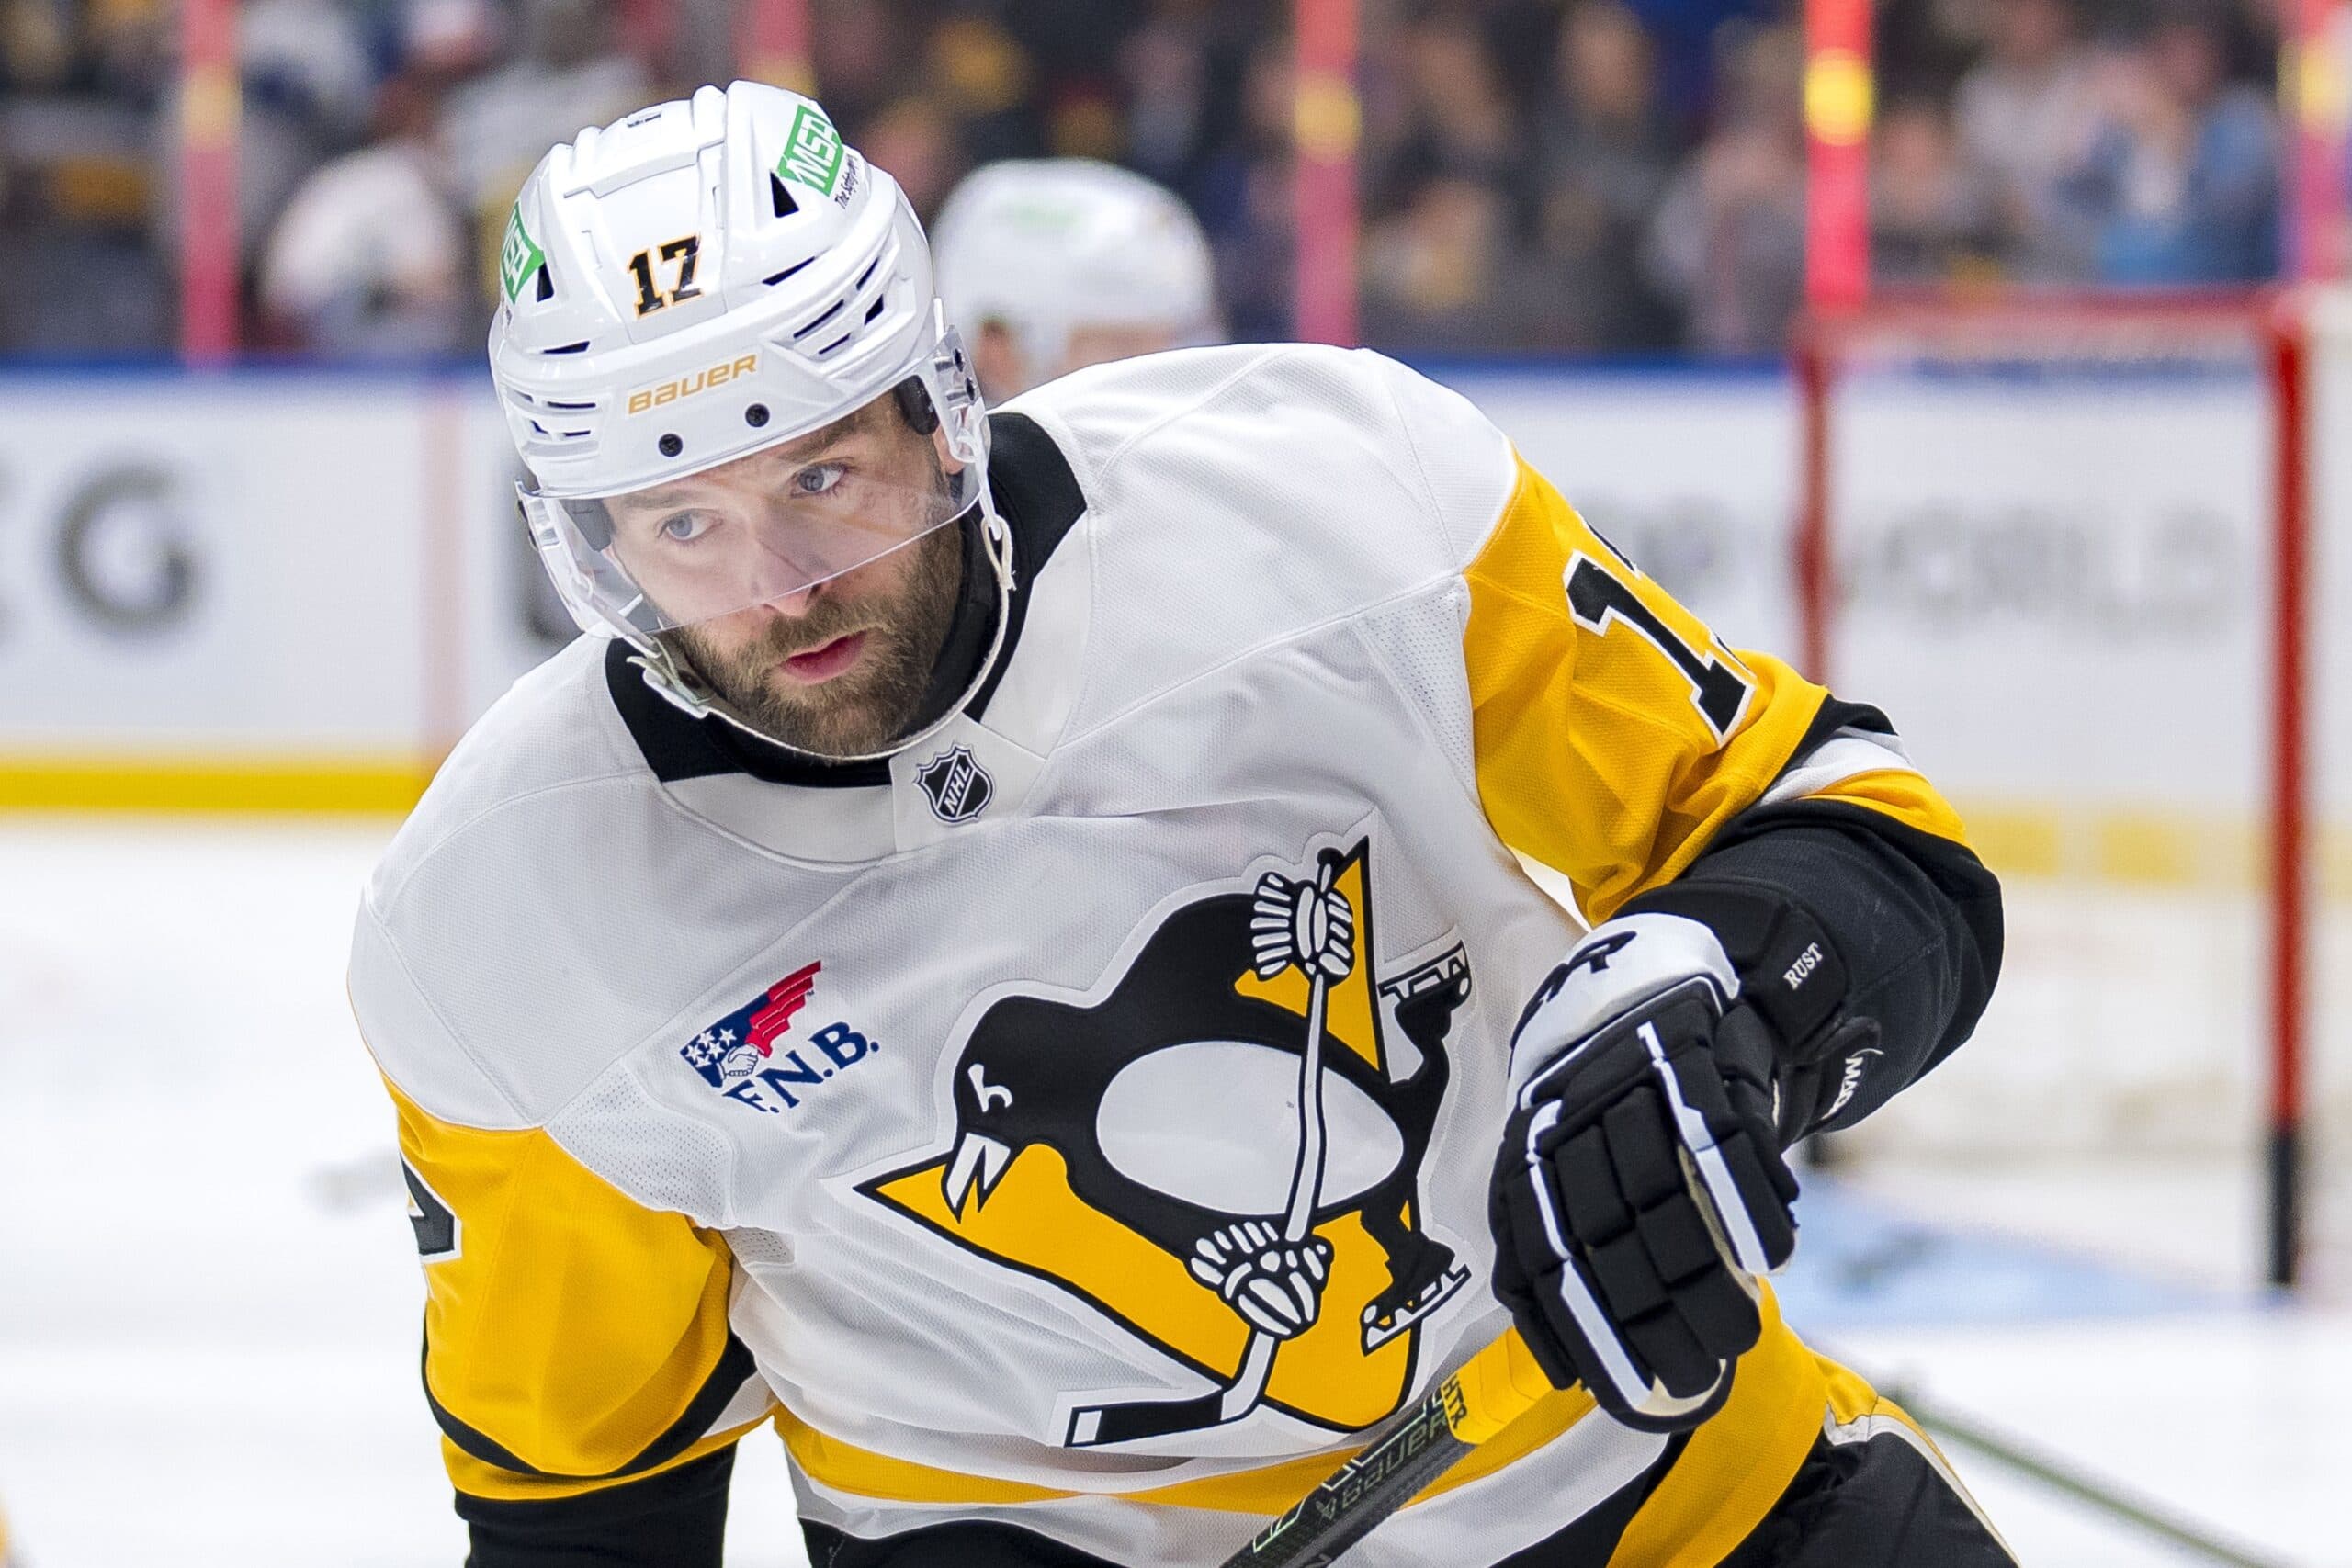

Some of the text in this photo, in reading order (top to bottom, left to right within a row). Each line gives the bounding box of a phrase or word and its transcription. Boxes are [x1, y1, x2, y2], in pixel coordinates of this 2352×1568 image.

[786, 112, 839, 189] MSA
[628, 232, 705, 319] 17
[628, 354, 757, 415] BAUER
[943, 764, 971, 815] NHL
[1782, 942, 1824, 990] RUST
[721, 1021, 879, 1113] F.N.B.
